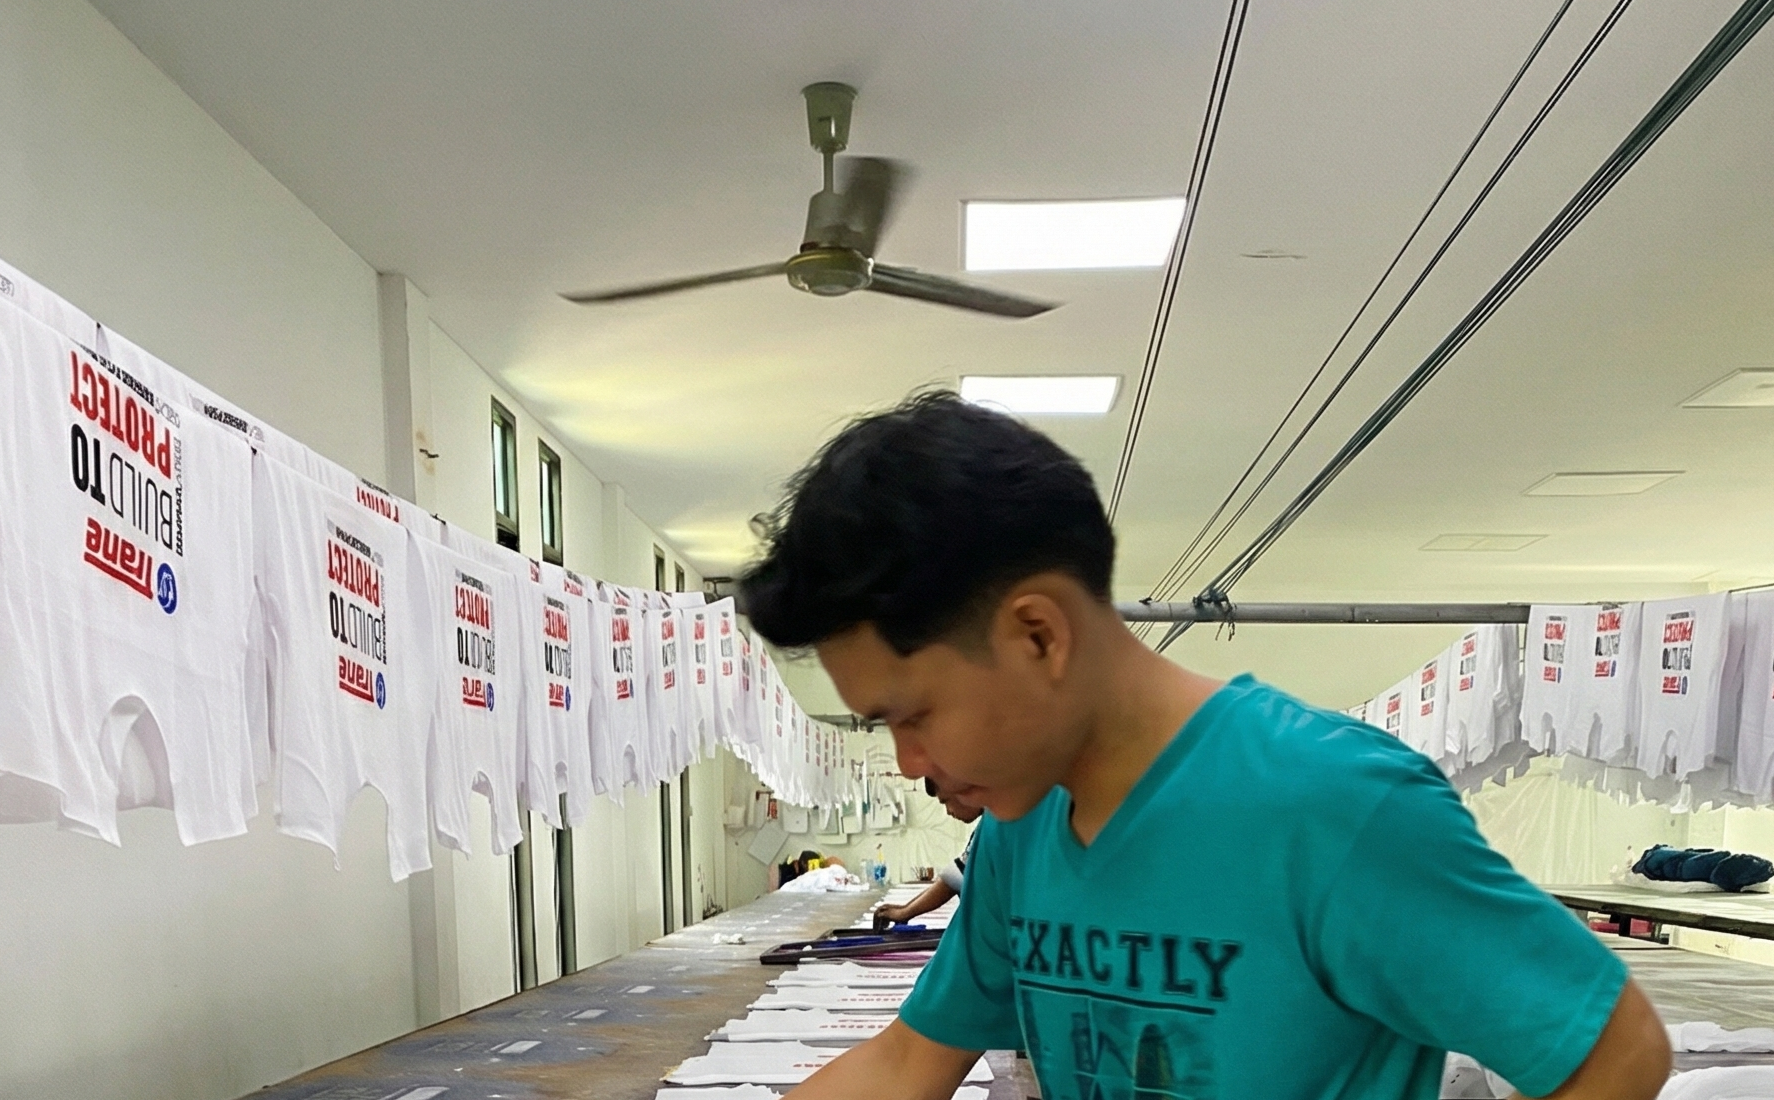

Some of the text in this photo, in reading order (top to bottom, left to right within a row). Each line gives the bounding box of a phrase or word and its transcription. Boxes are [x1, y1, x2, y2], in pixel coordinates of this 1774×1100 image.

[70, 350, 172, 480] PROTECT
[70, 423, 106, 506] TO
[109, 452, 174, 551] BUILD
[84, 516, 154, 600] Trane
[327, 538, 380, 608] PROTECT
[329, 590, 348, 645] TO
[338, 654, 375, 704] Trane
